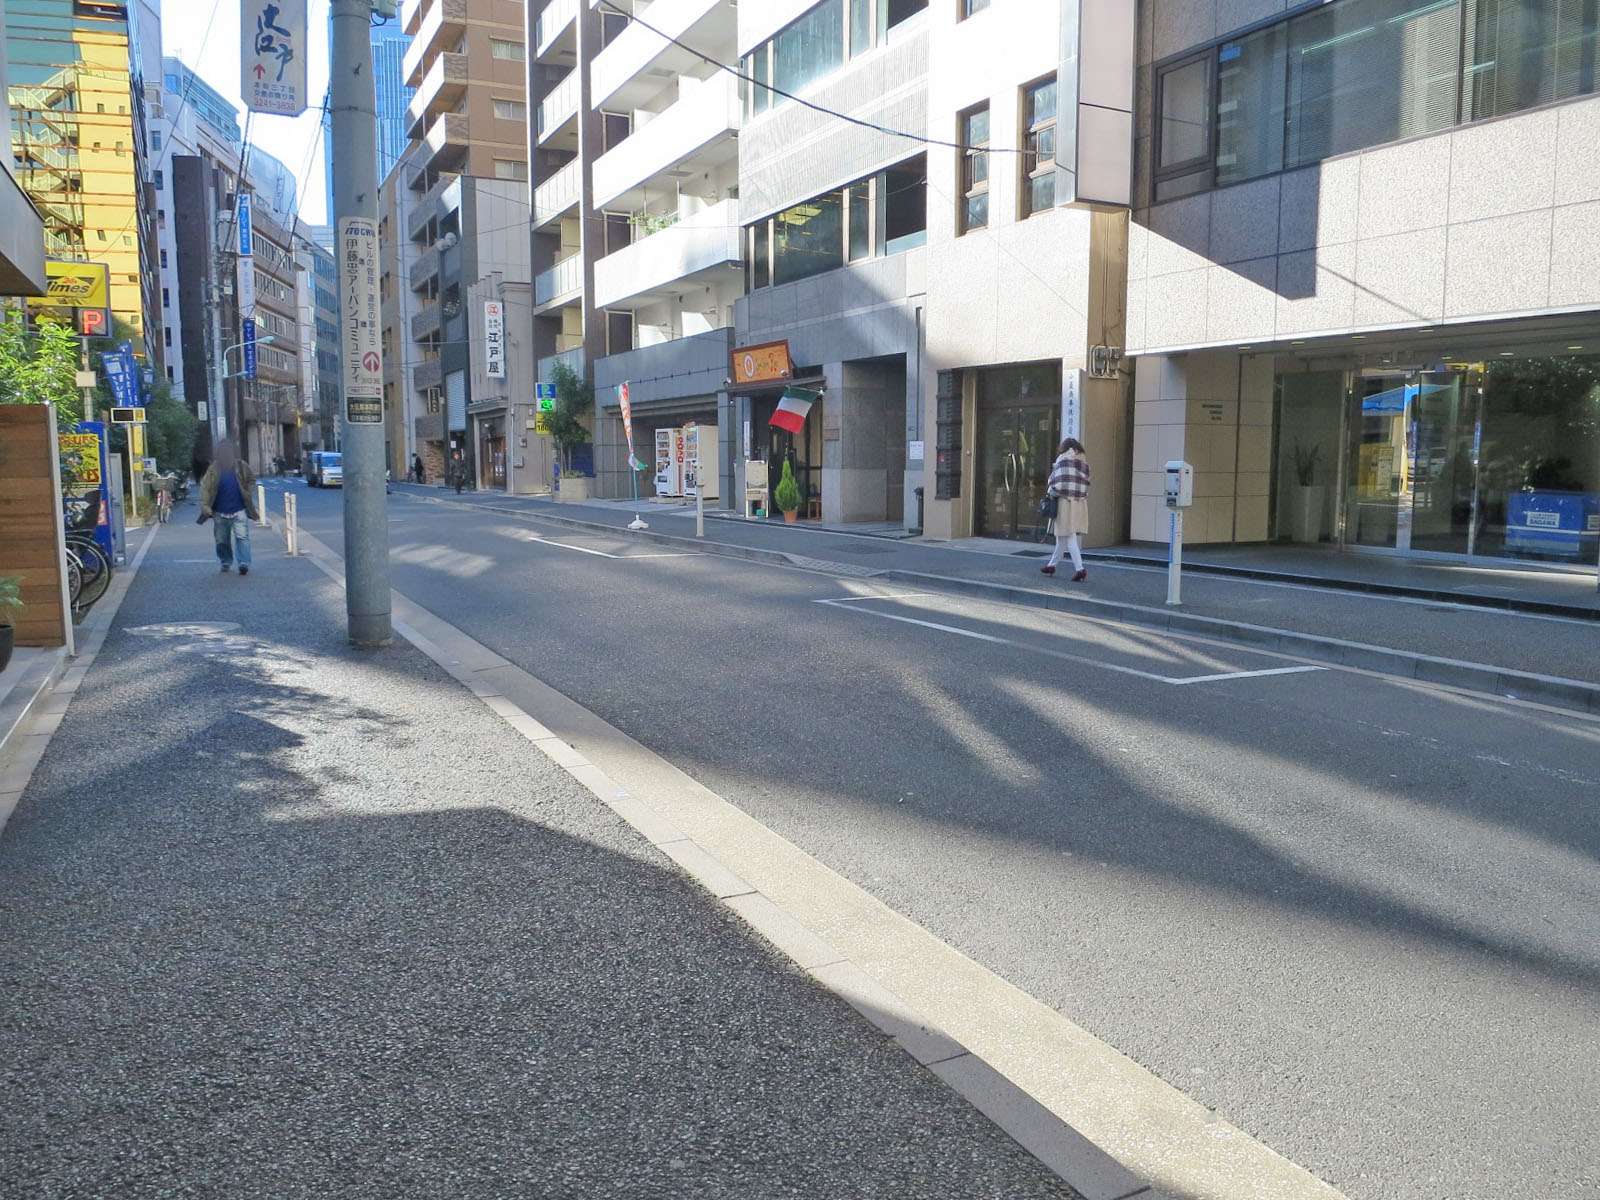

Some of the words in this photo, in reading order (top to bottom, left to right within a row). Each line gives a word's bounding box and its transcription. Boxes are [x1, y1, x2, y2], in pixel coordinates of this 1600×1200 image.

[83, 310, 104, 335] P
[346, 238, 360, 383] 伊藤忠アーバンコミュニティ
[488, 332, 499, 373] 江戸屋
